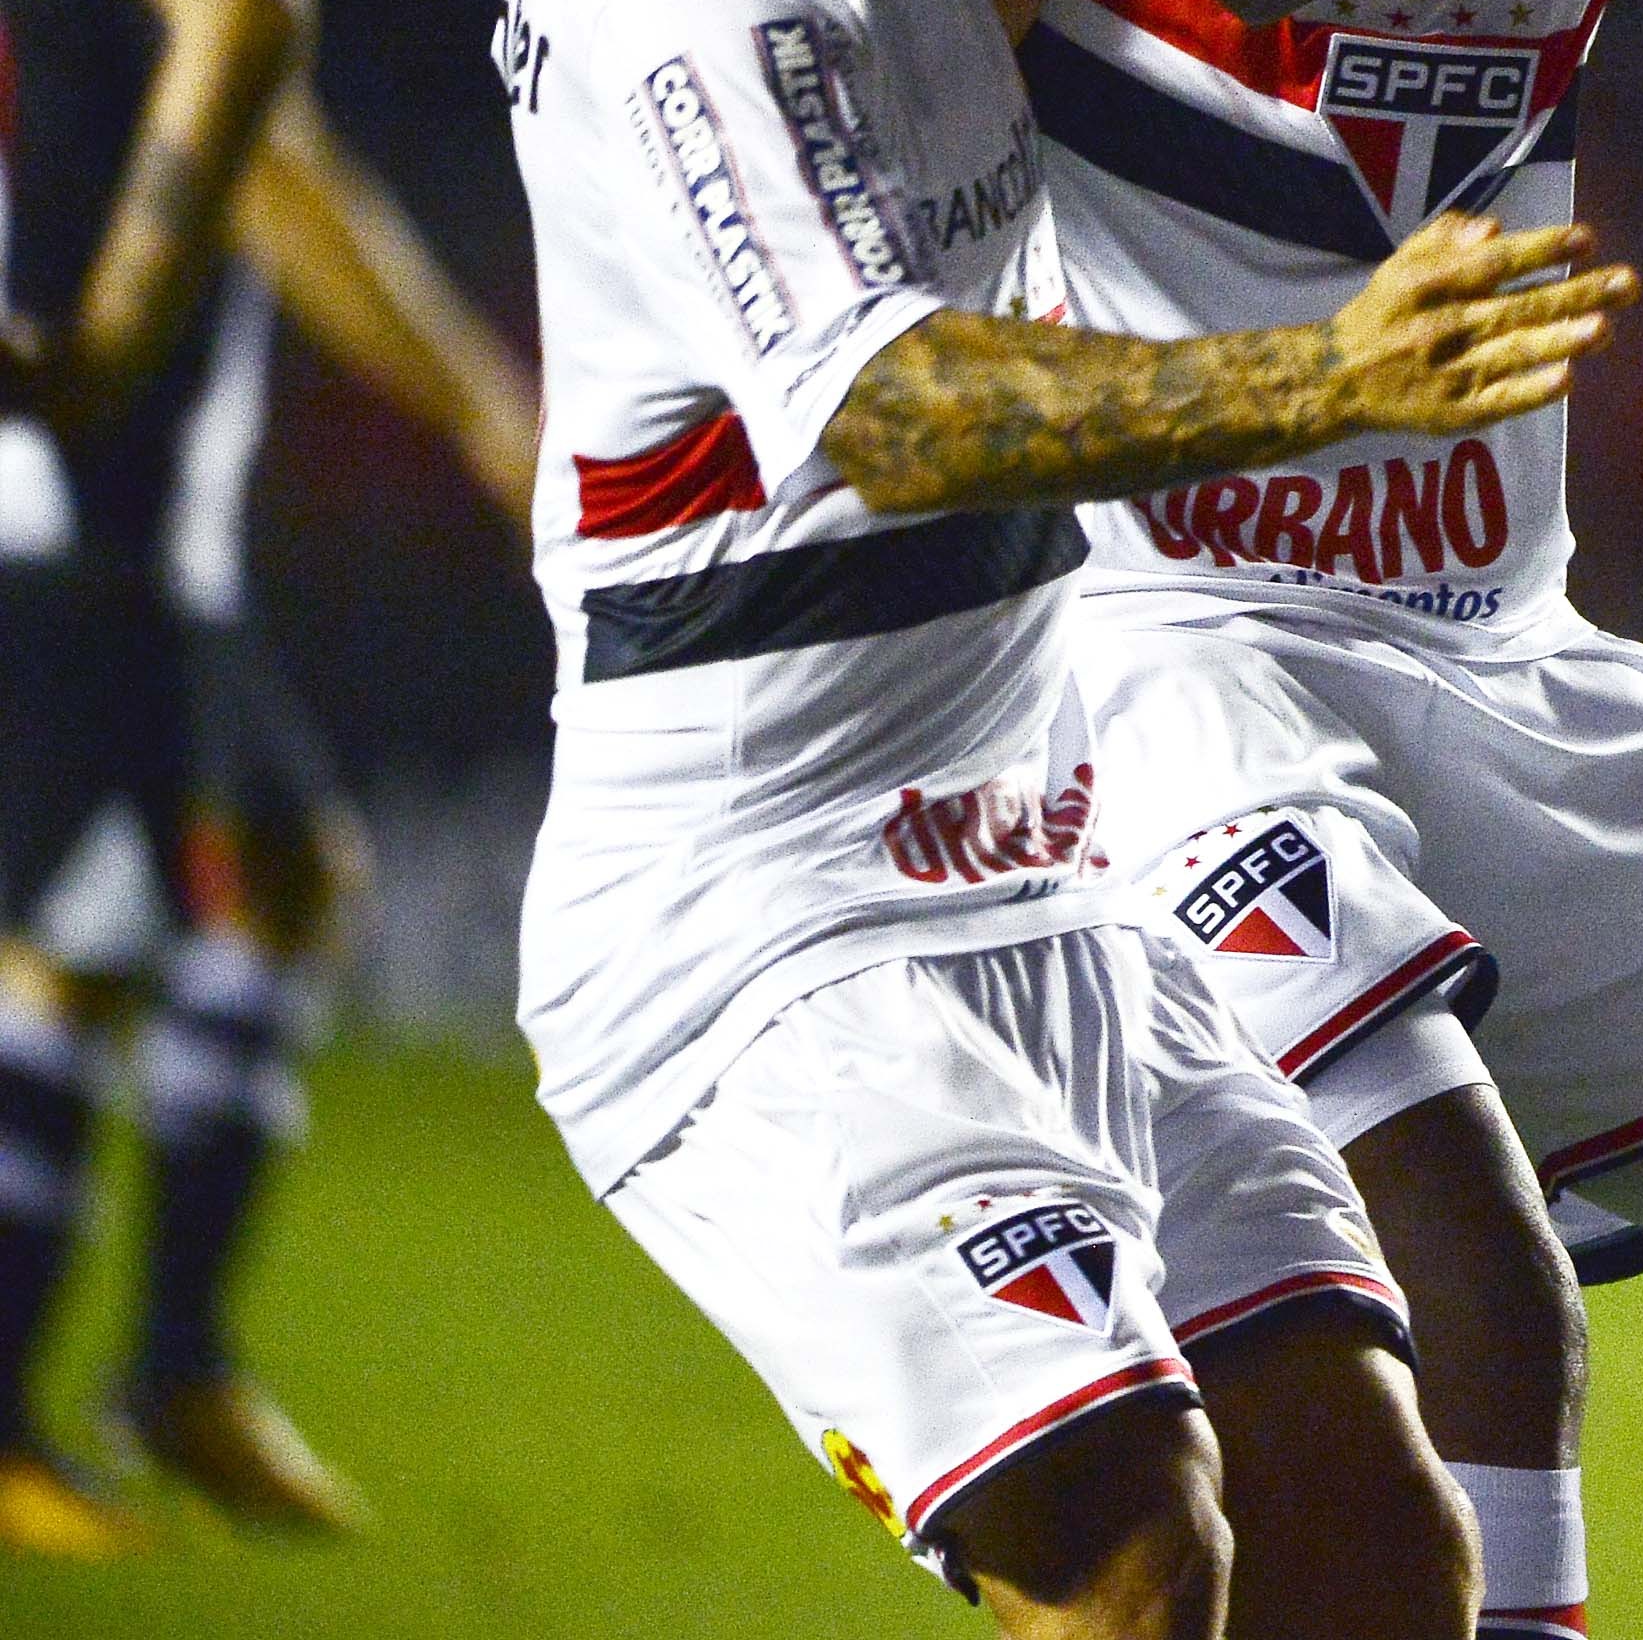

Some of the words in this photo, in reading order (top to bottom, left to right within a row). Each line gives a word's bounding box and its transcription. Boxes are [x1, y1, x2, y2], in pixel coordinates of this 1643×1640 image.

[650, 62, 722, 190] CORR
[1336, 54, 1521, 111] SPFC
[1132, 438, 1509, 586] URBANO
[1196, 831, 1310, 935] SPFC
[969, 1201, 1105, 1278] SPFC
